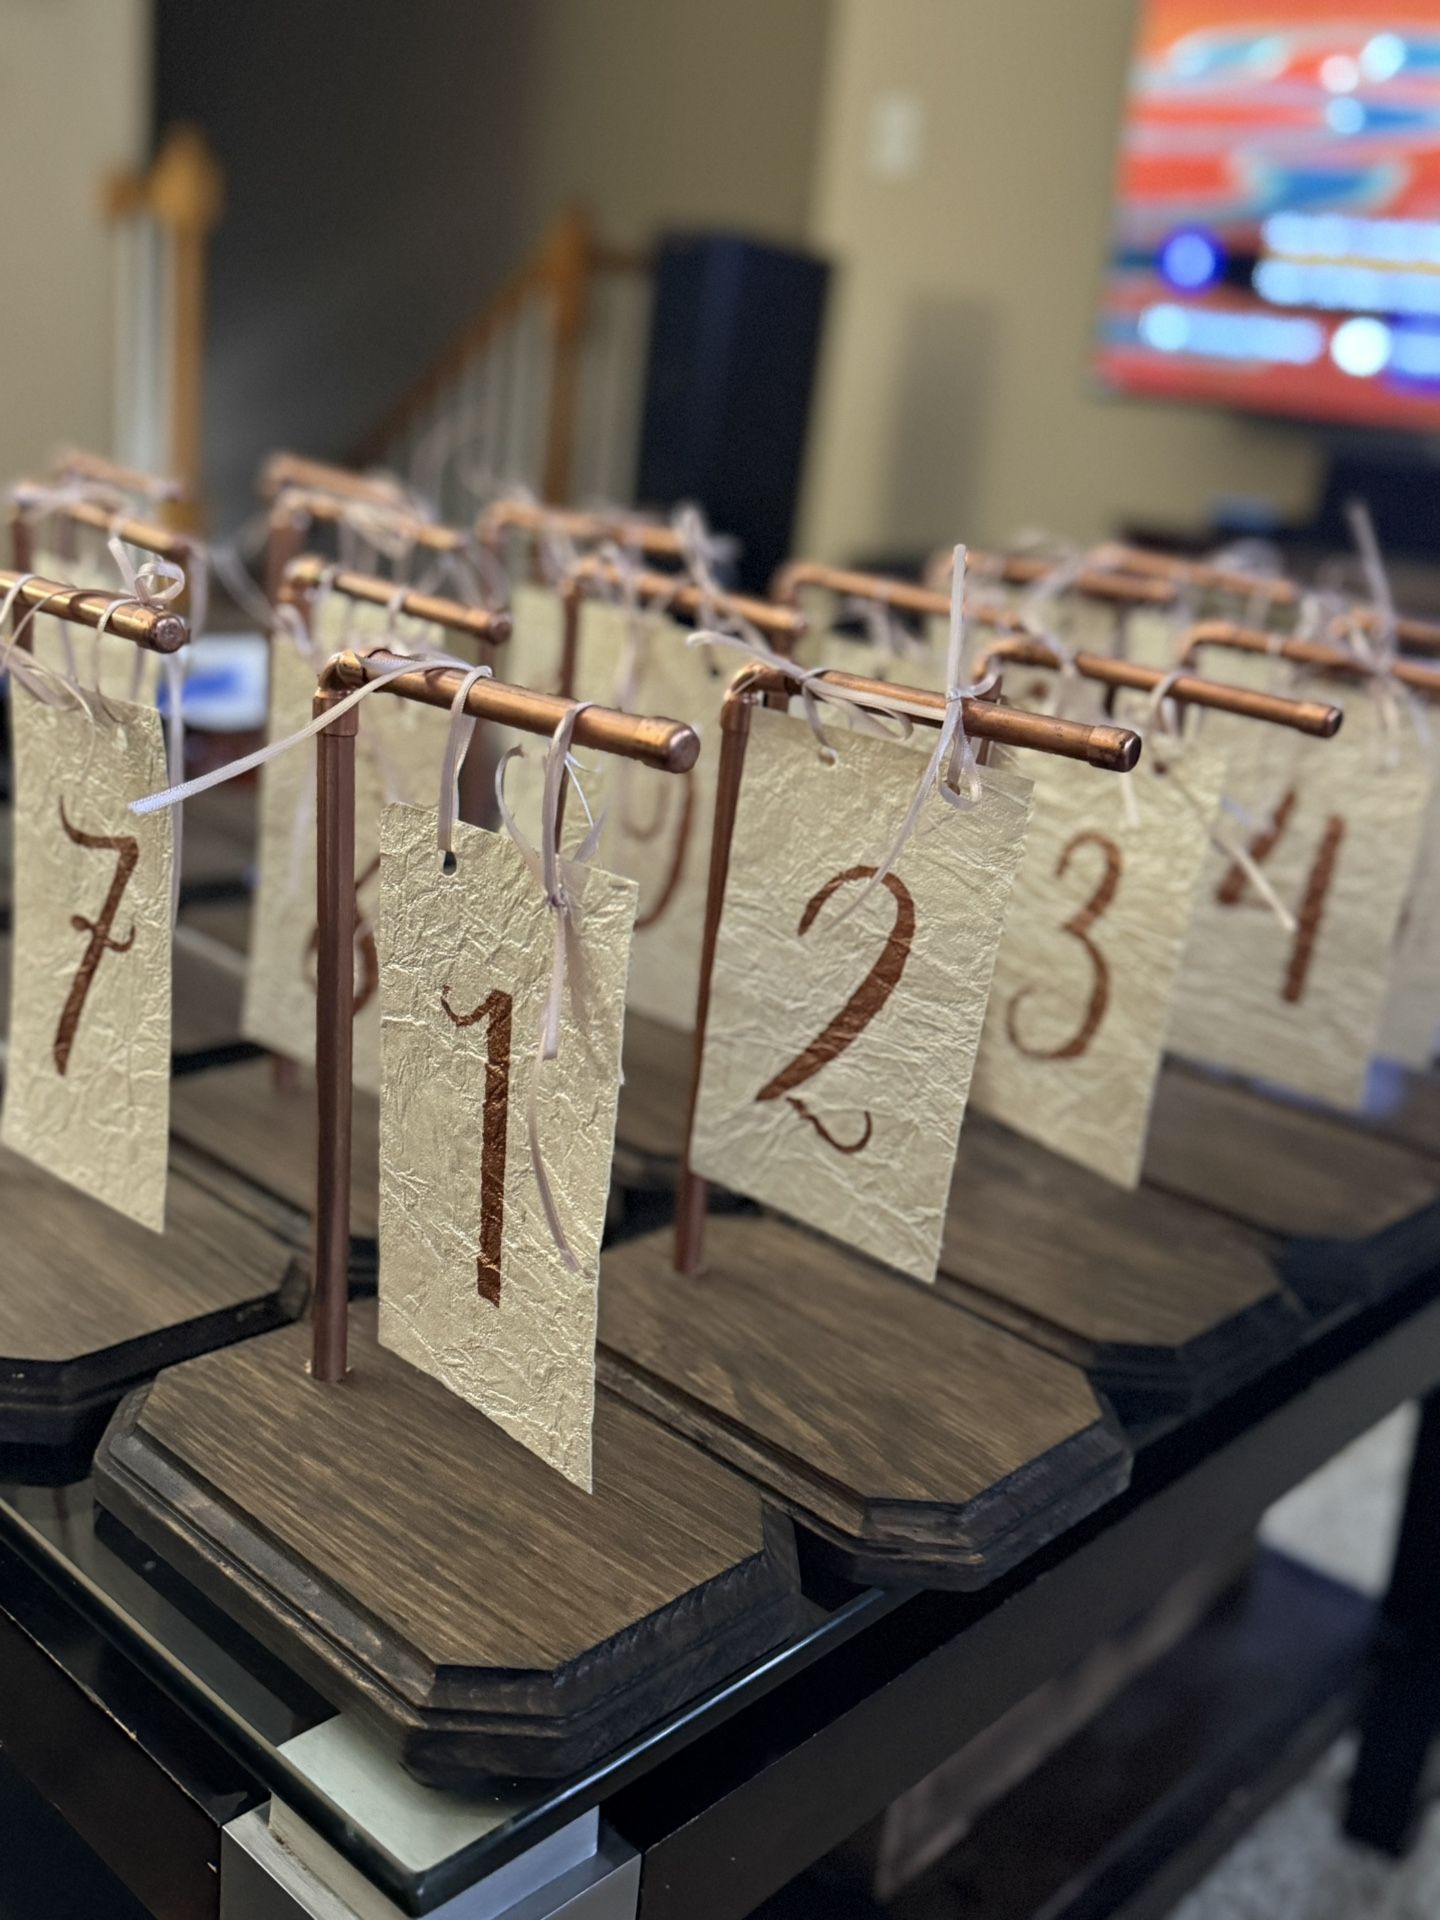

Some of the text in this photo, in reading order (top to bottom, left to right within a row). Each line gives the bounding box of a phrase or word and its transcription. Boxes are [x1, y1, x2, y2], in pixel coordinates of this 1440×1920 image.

[54, 794, 139, 1076] 7
[756, 865, 915, 1153] 2
[1006, 832, 1123, 1060] 3
[1214, 786, 1347, 1004] 4
[440, 985, 513, 1308] 1
